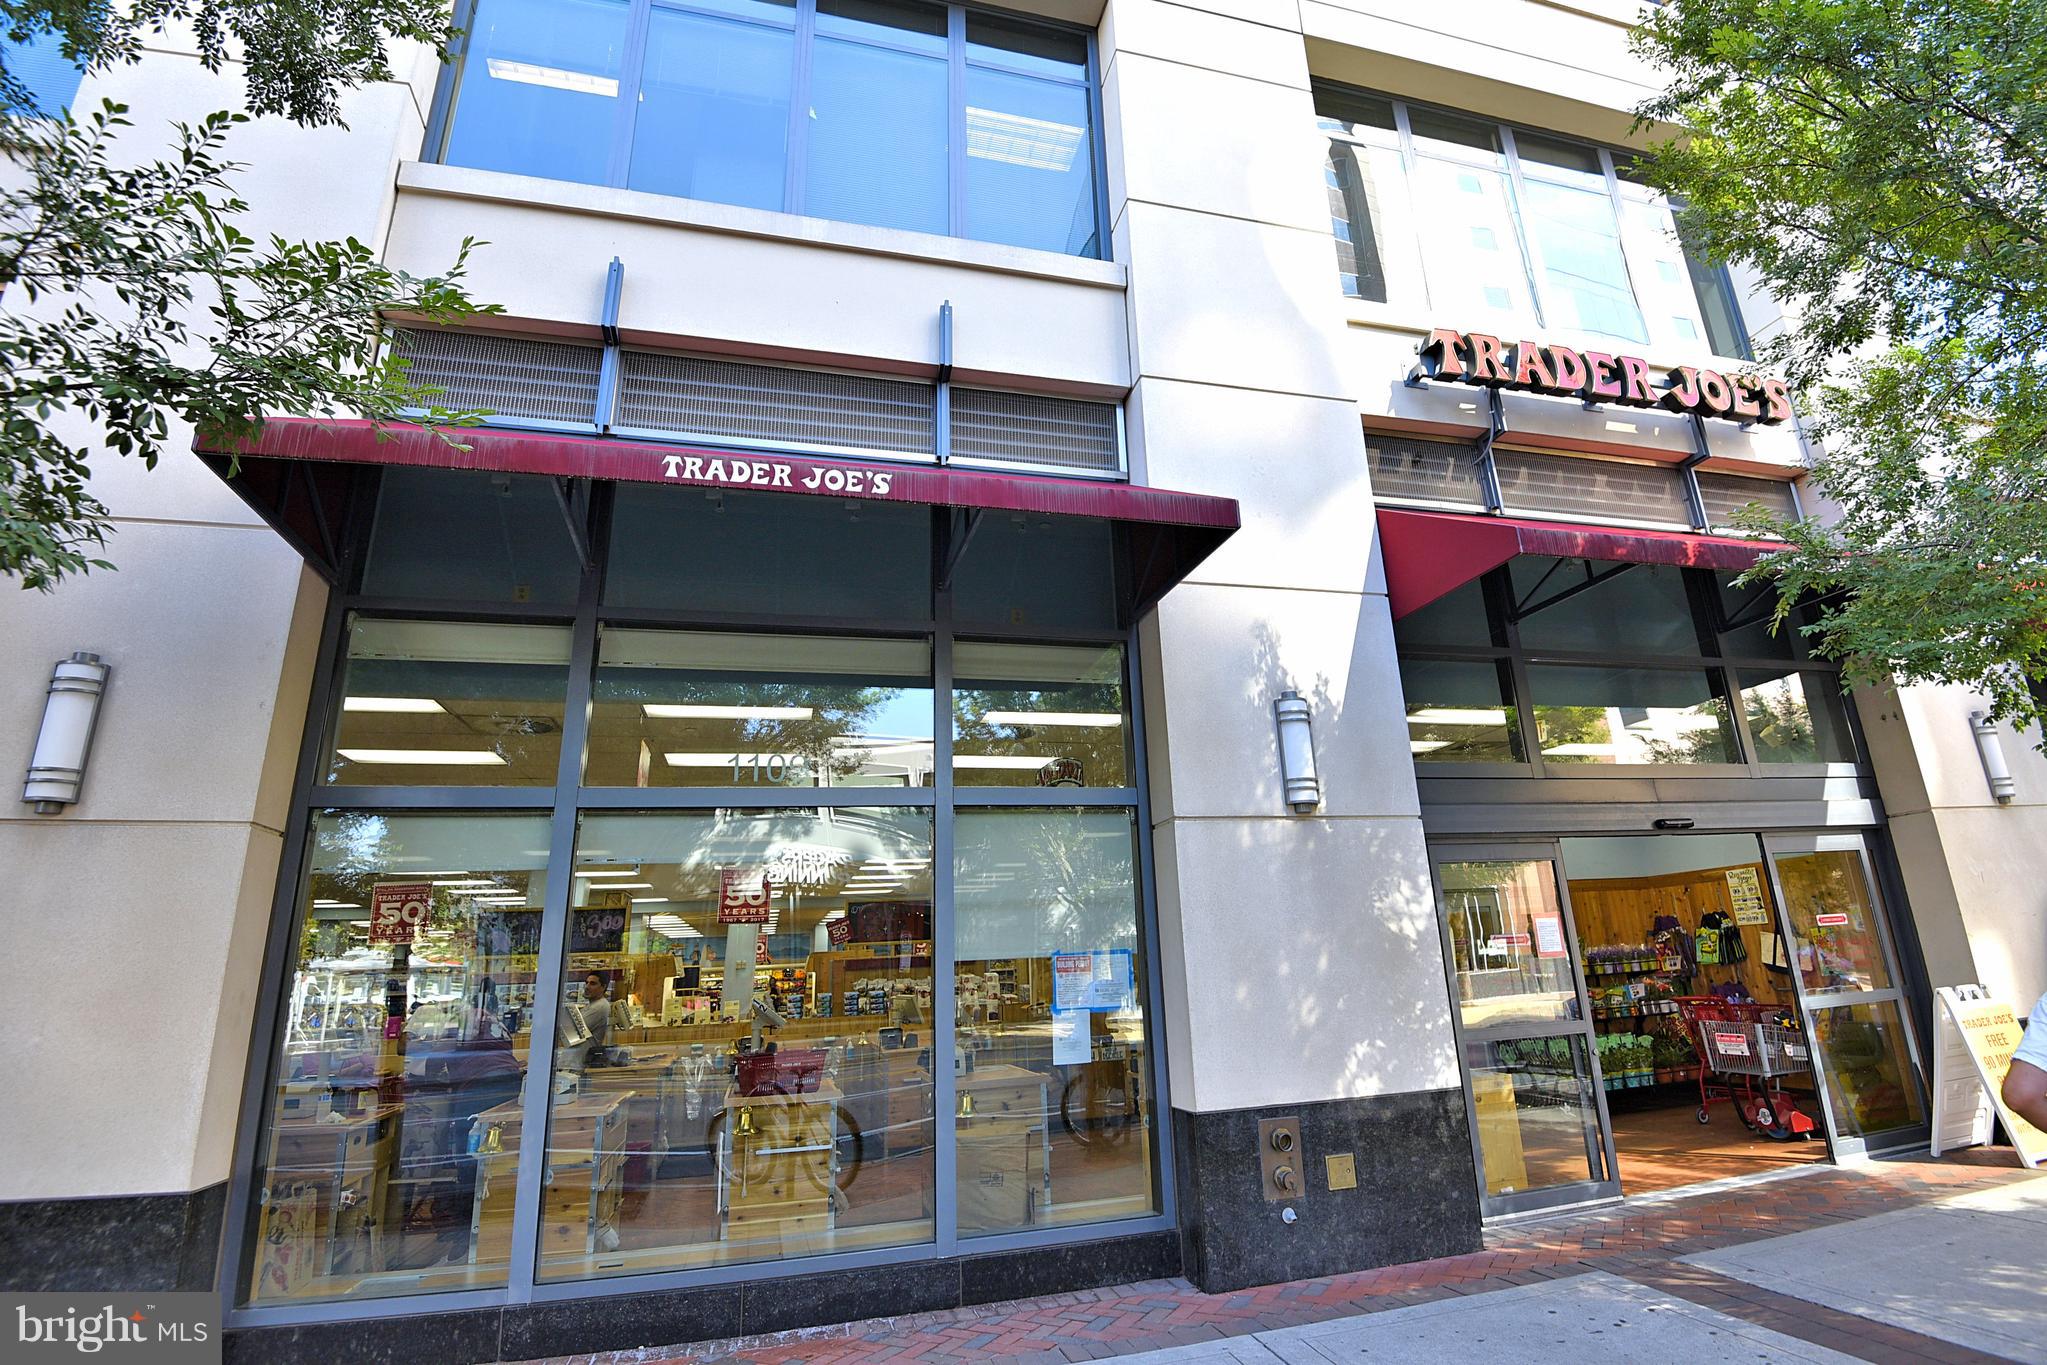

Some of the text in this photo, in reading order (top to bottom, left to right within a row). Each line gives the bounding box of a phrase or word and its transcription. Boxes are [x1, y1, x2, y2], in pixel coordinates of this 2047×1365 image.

[1428, 328, 1792, 422] TRADER JOE'S
[661, 454, 893, 494] TRADER JOE'S
[725, 885, 767, 906] 50
[380, 901, 426, 925] 50
[724, 907, 766, 915] YEARS
[376, 926, 416, 935] YEAR
[832, 925, 848, 937] 50
[1962, 1013, 2014, 1030] TRADER JOE'S
[1985, 1032, 2009, 1047] FREE
[1983, 1055, 1997, 1070] 90
